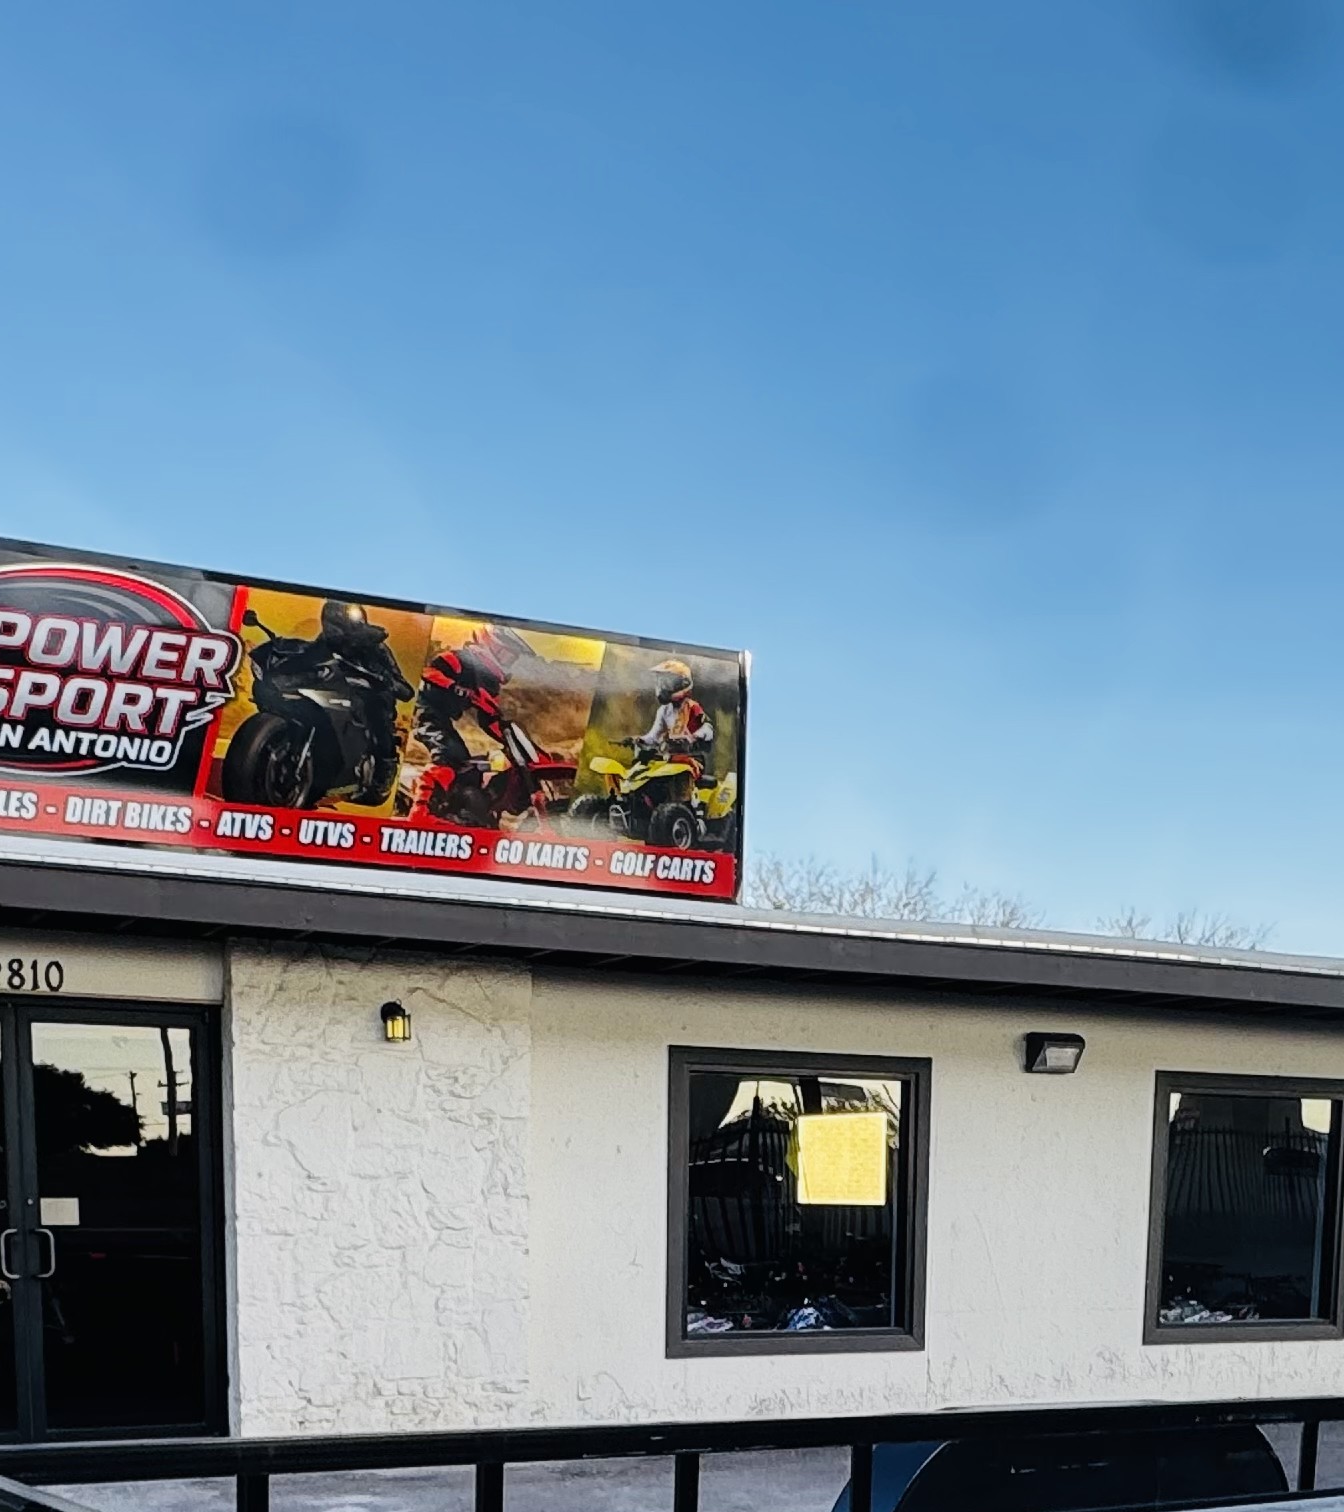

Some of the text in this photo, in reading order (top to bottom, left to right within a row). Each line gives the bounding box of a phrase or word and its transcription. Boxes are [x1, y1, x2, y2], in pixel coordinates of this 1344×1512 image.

[27, 729, 174, 764] ANTONIO
[64, 796, 123, 825] DIRT
[123, 801, 192, 833] BIKES
[216, 811, 274, 841] ATVS
[298, 818, 356, 849] UTVS
[380, 826, 473, 860] TRAILERS
[494, 838, 526, 865] GO
[526, 842, 590, 871] KARTS
[609, 850, 656, 878] GOLF
[656, 855, 717, 884] CARTS
